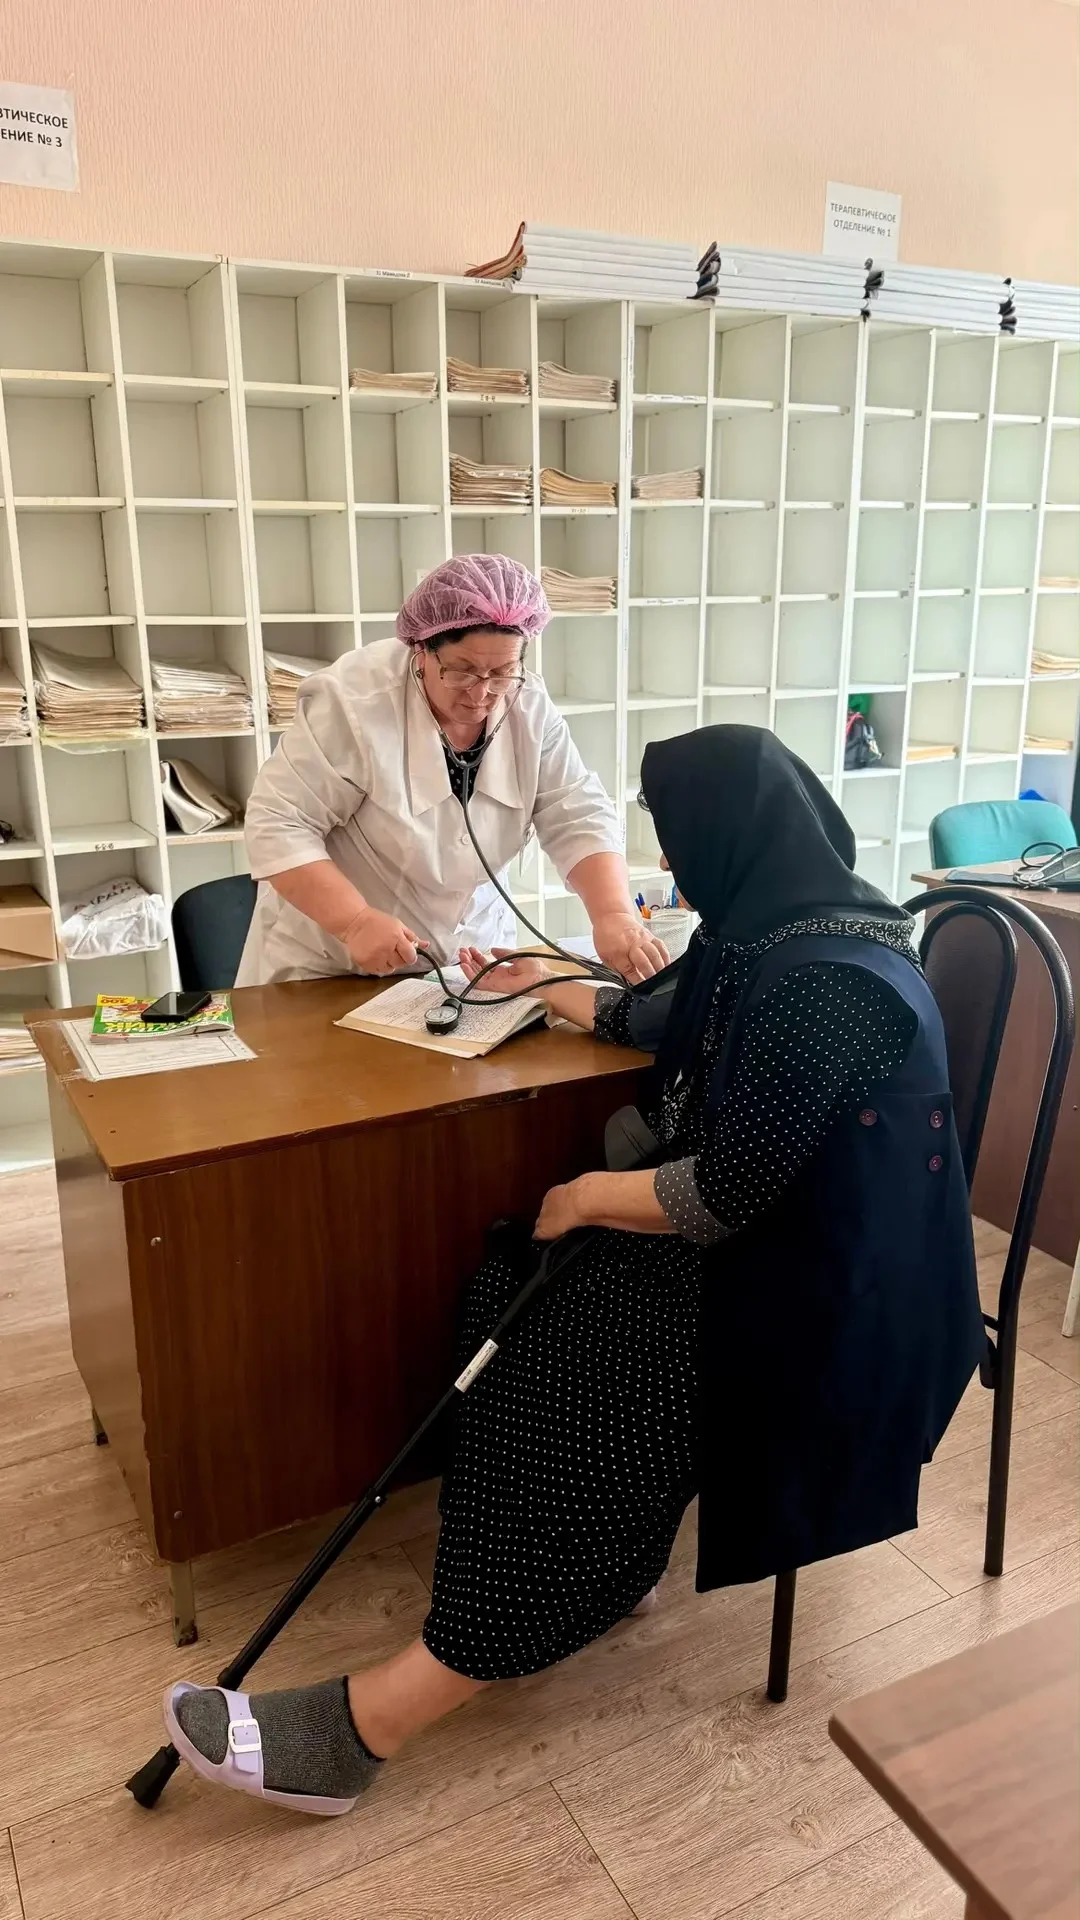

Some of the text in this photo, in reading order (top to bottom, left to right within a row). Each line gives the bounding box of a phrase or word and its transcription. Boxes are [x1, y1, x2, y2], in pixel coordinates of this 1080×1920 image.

[55, 136, 63, 148] 3
[830, 202, 896, 223] ТЕРАПЕВТИЧЕСКОЕ
[833, 219, 876, 235] ОТДЕЛЕНИЕ
